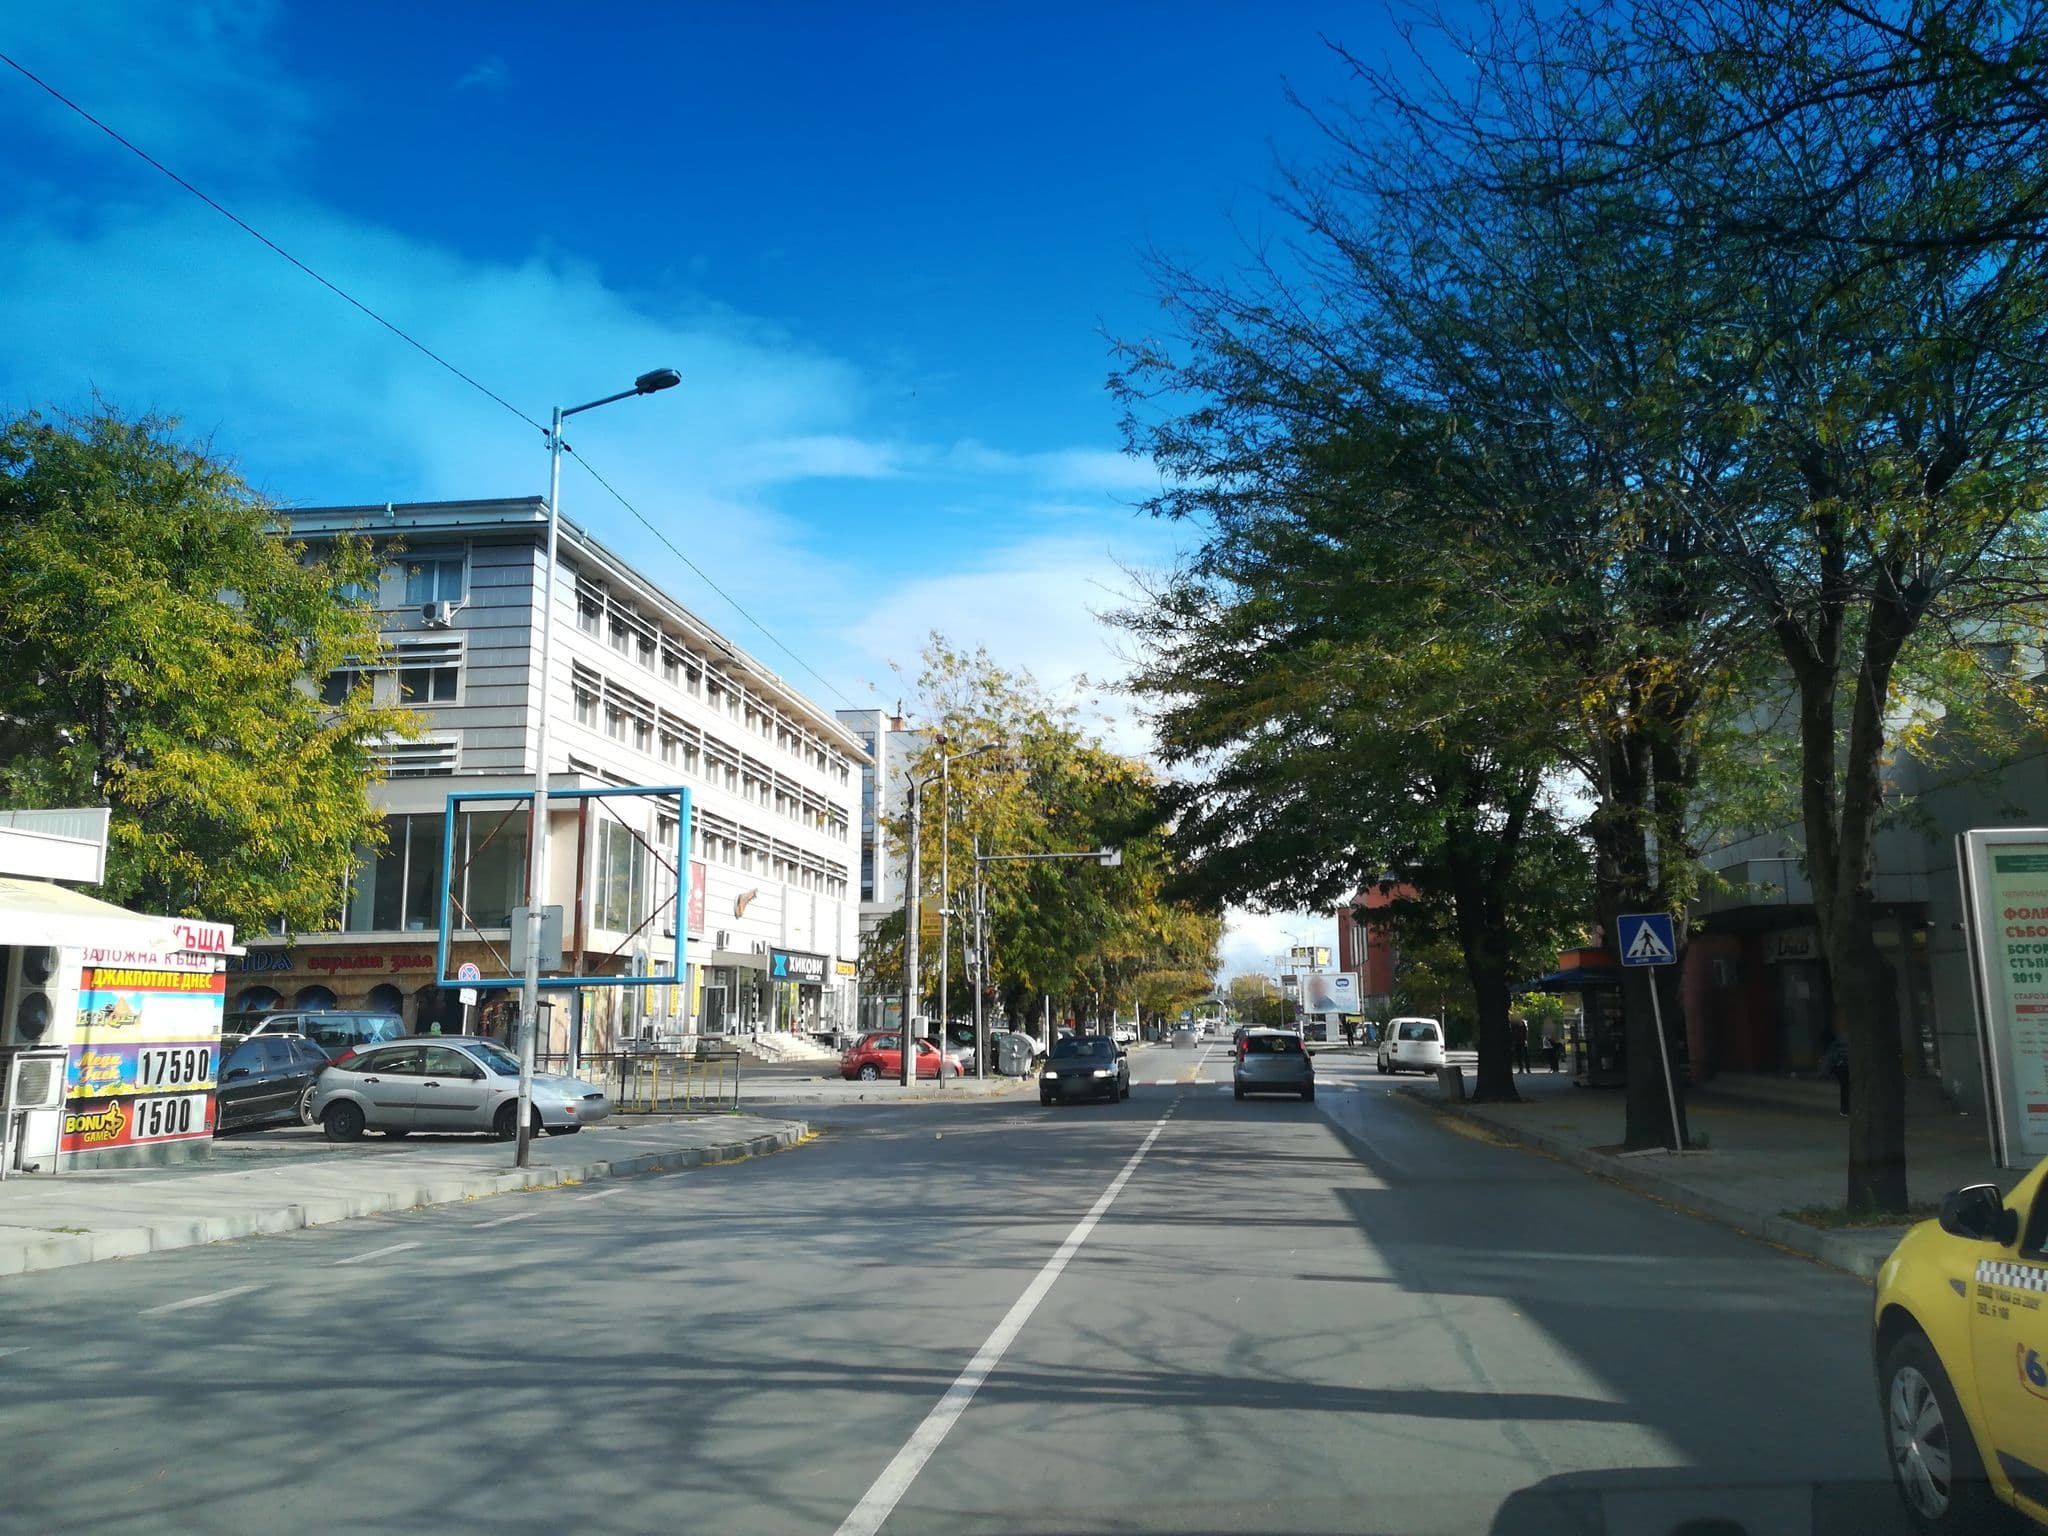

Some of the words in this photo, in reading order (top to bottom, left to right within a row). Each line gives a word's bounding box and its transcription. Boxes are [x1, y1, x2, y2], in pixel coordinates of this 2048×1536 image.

[164, 952, 208, 968] КЪЩА
[788, 956, 824, 975] ХИКОВИ
[92, 968, 180, 988] ДЖАКПОТИТЕ
[180, 972, 213, 991] ДНЕС
[2012, 973, 2042, 983] 2019
[143, 1049, 209, 1085] 17590
[138, 1098, 192, 1137] 1500
[84, 1131, 109, 1142] GAME
